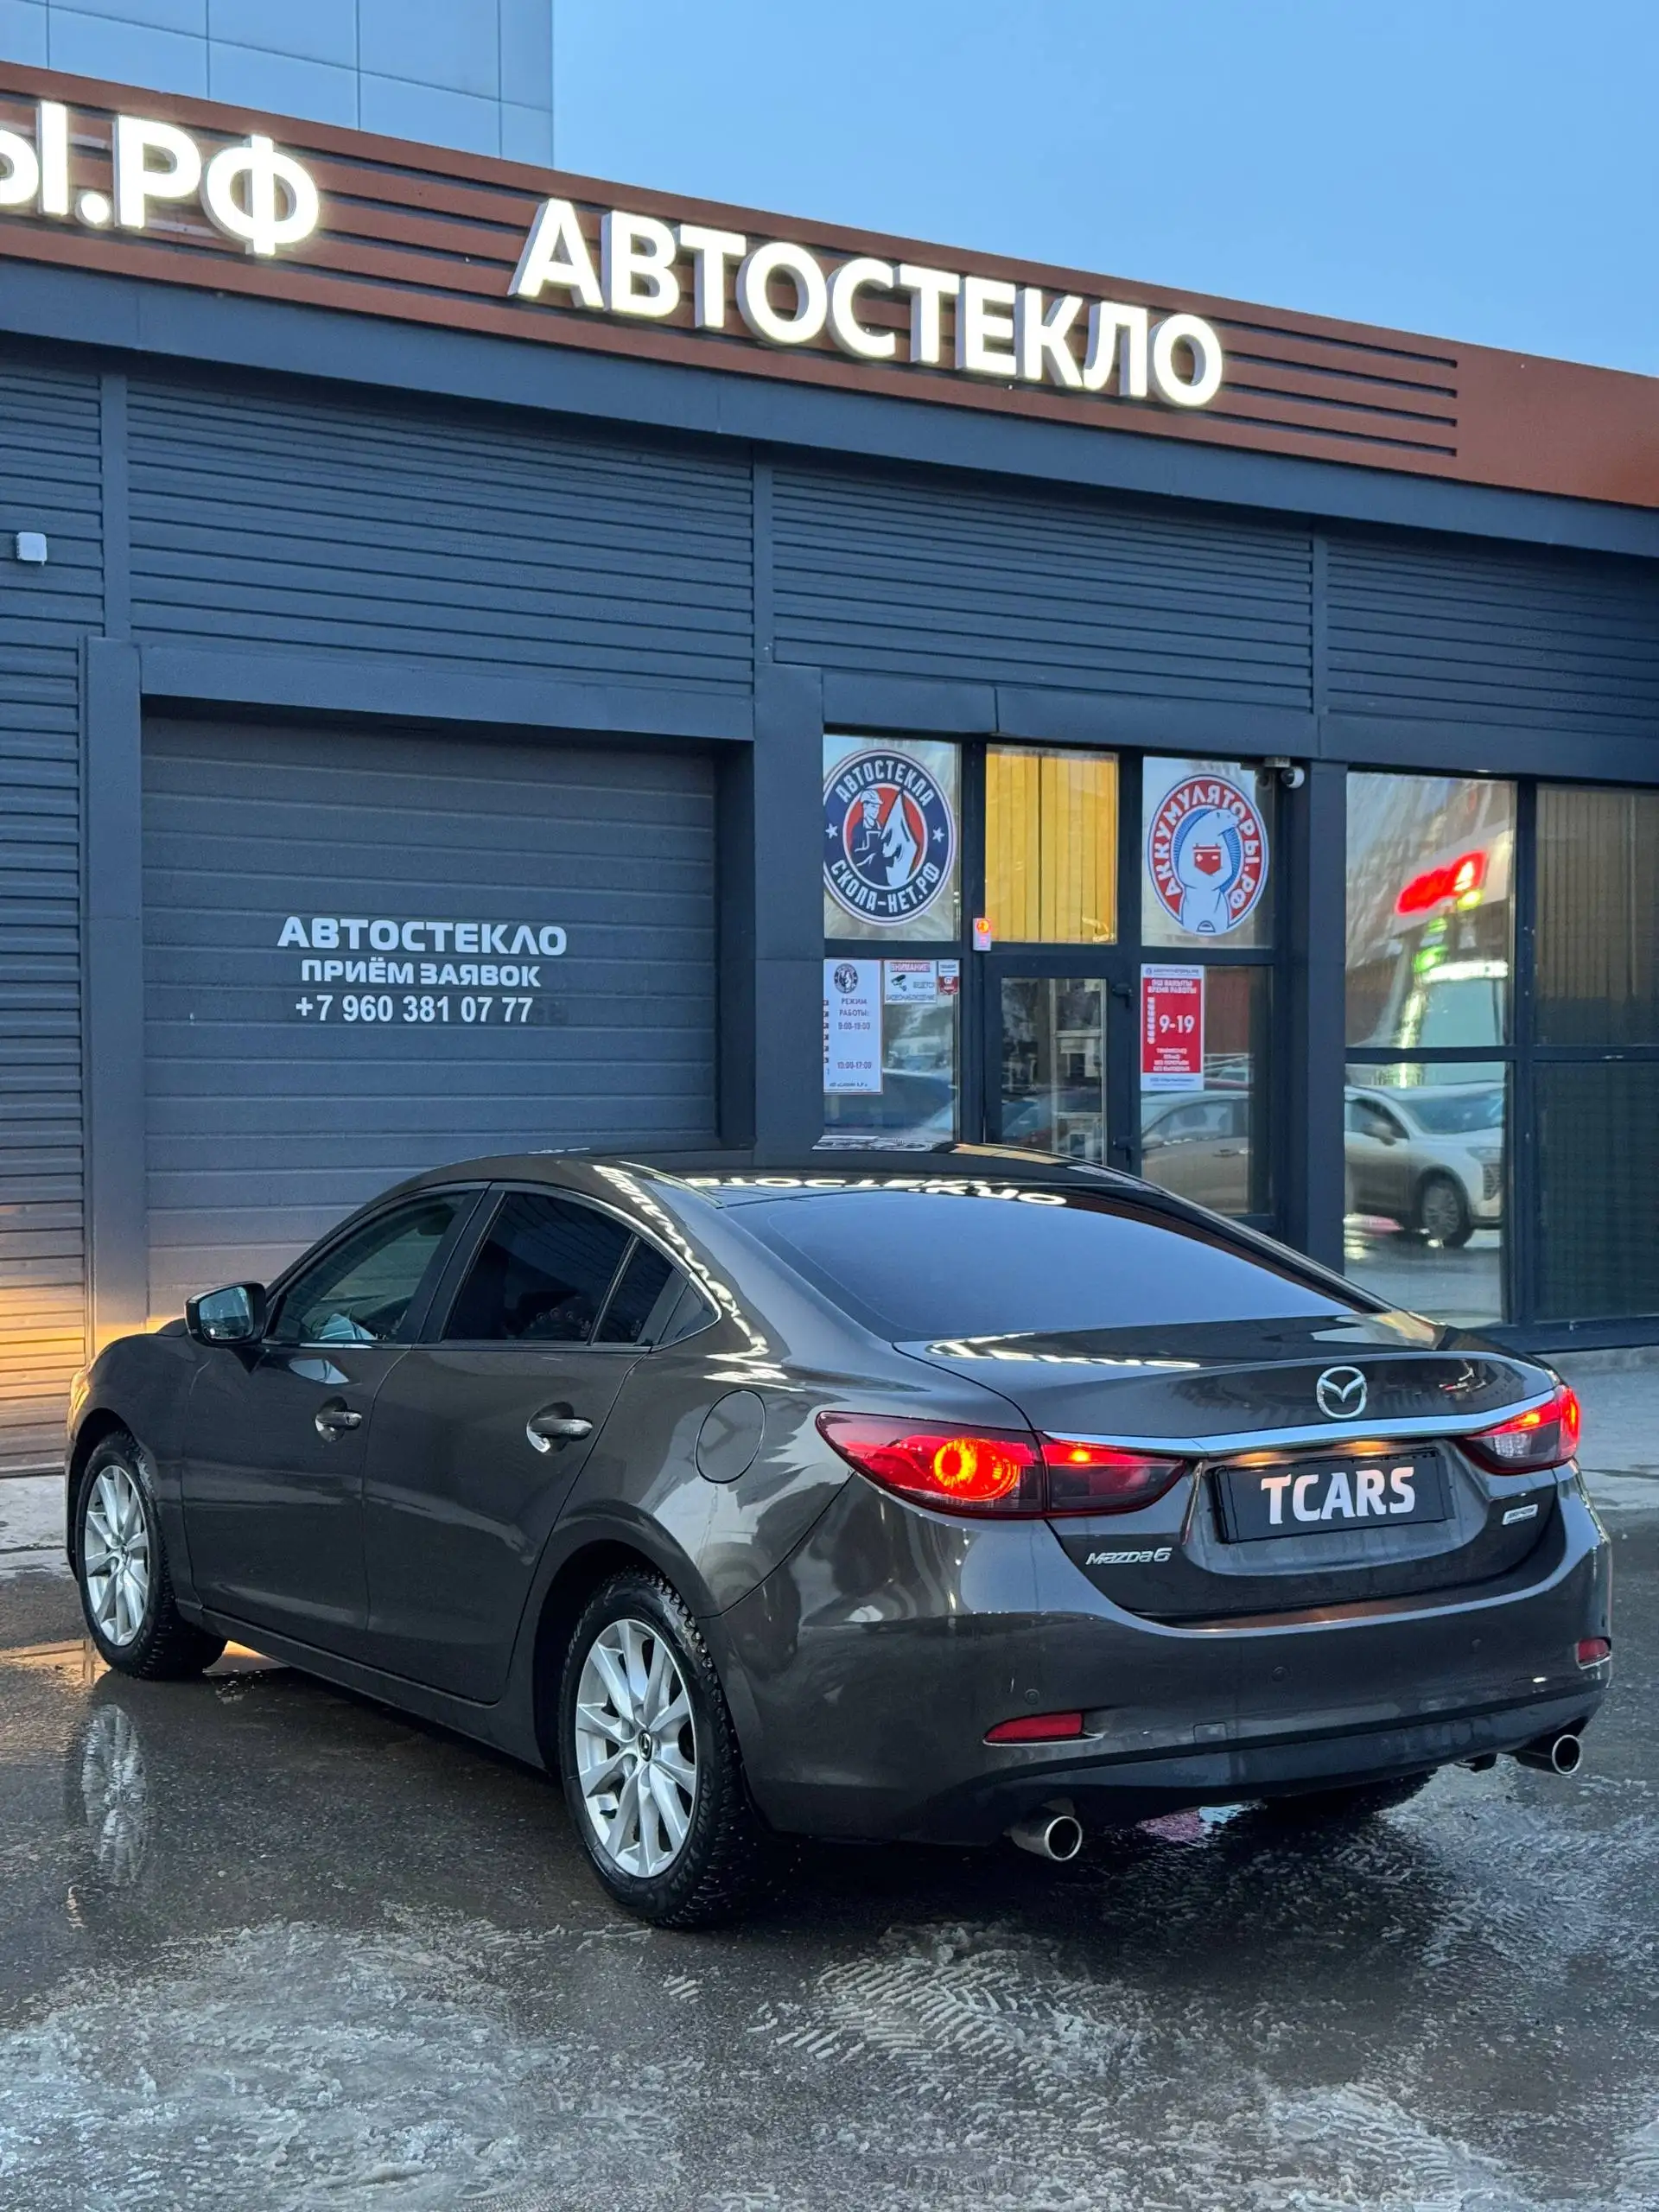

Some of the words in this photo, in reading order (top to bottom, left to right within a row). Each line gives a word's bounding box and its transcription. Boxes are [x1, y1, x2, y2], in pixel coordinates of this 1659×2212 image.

[509, 198, 1223, 407] АВТОСТЕКЛО
[835, 760, 935, 806] АВТОСТЕКЛА
[830, 860, 940, 913] СКОЛА-НЕТ.РФ
[277, 916, 567, 956] АВТОСТЕКЛО
[302, 957, 415, 984] ПРИЁМ
[420, 963, 542, 988] ЗАЯВОК
[296, 995, 334, 1020] +7
[342, 995, 394, 1022] 960
[403, 996, 450, 1022] 381
[461, 997, 493, 1023] 07
[502, 997, 533, 1023] 77
[1160, 1014, 1195, 1033] 9-19
[1261, 1466, 1415, 1525] TCARS
